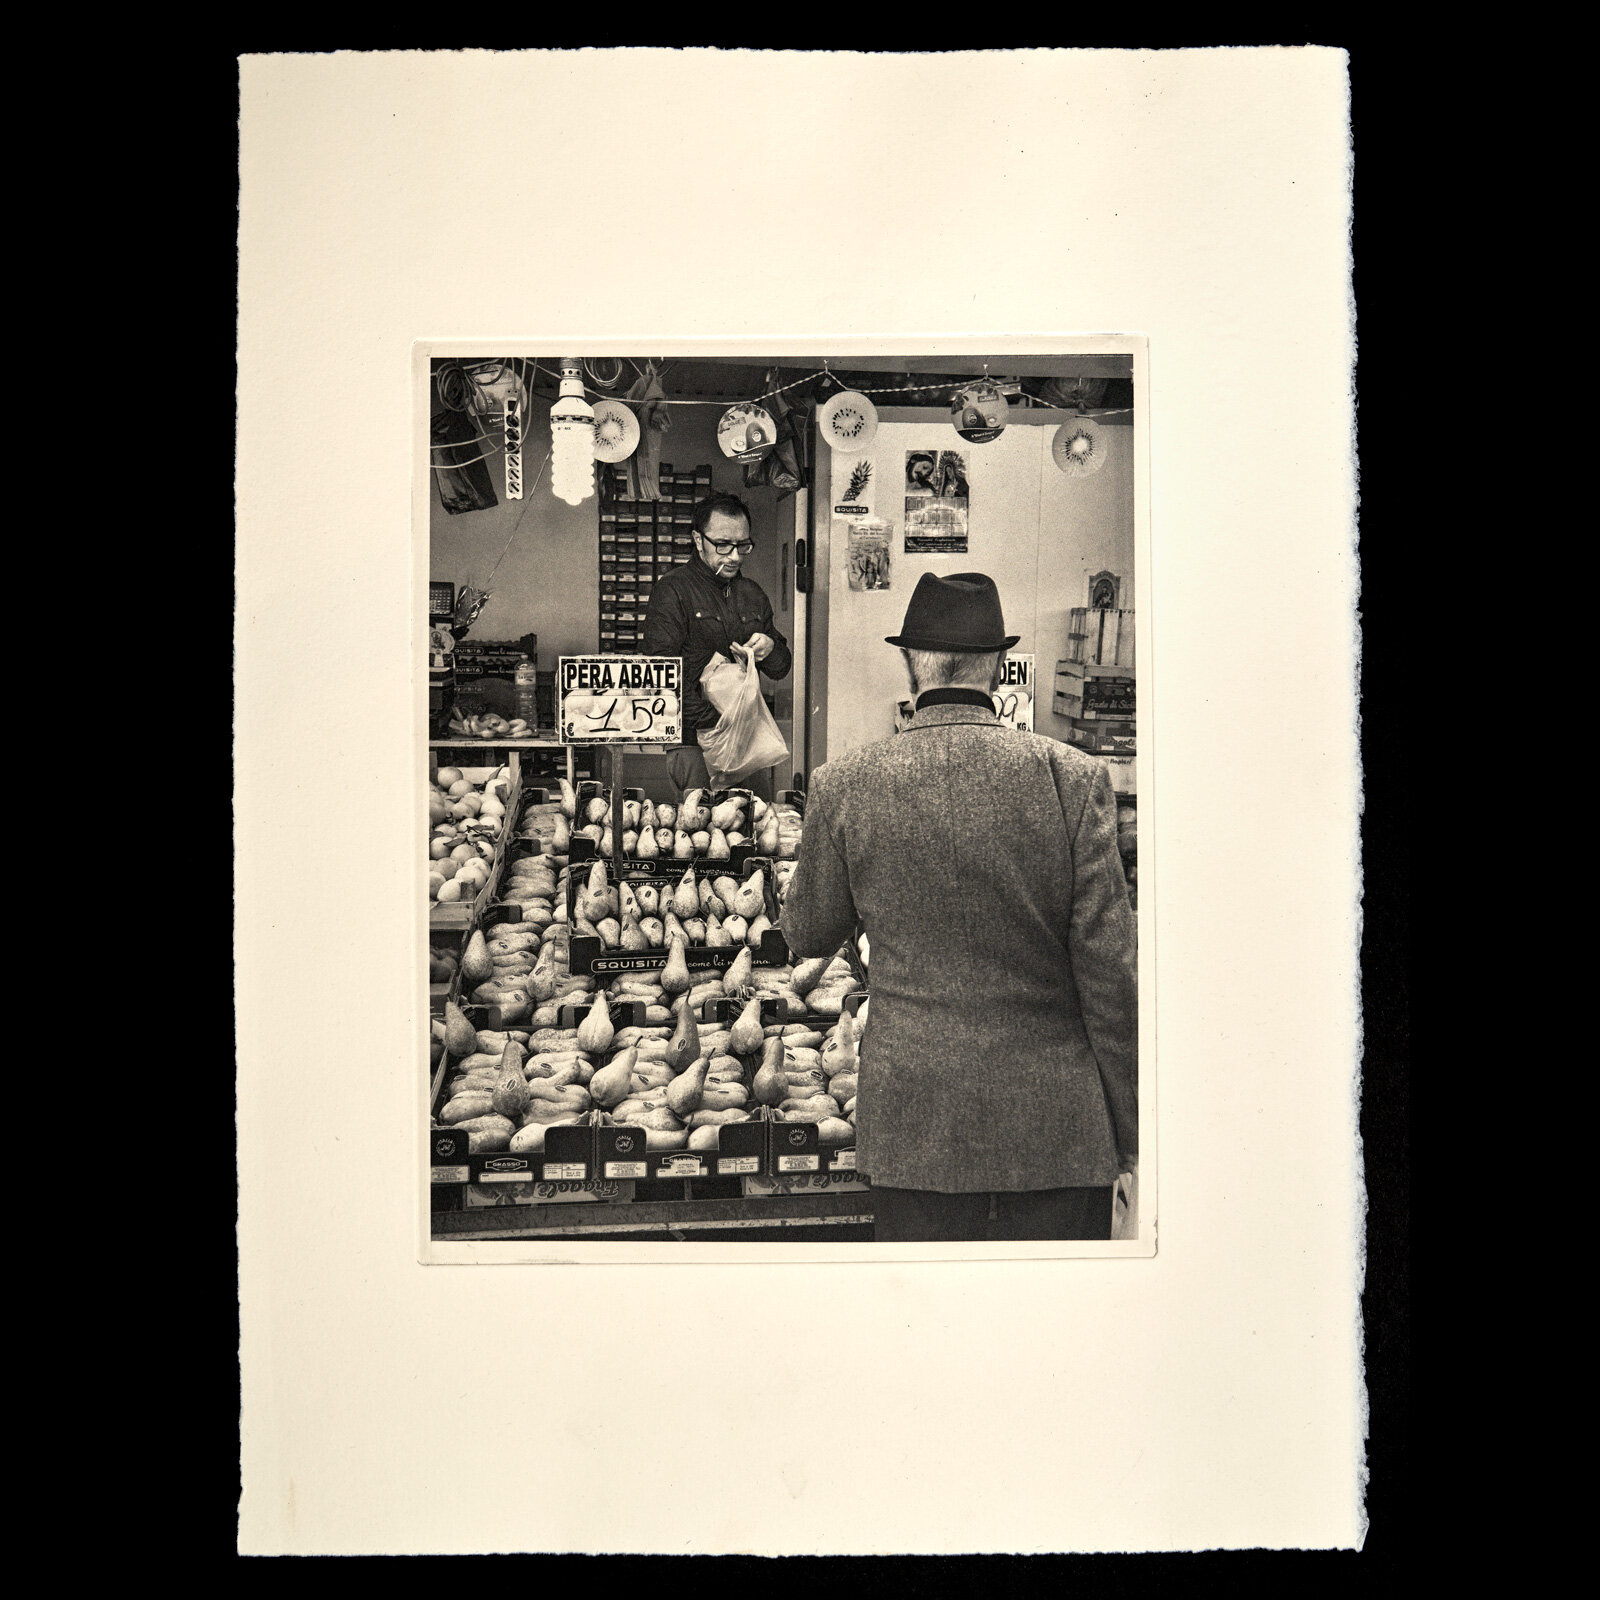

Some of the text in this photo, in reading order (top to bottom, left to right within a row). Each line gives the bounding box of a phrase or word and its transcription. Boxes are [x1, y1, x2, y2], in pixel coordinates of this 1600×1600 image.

[566, 664, 675, 689] PERA ABATE
[1000, 661, 1027, 685] DEN
[566, 722, 574, 737] €
[665, 725, 676, 735] KG
[1016, 722, 1027, 731] KG
[597, 959, 667, 970] SQUISITA
[687, 960, 711, 968] come
[713, 955, 725, 967] lei
